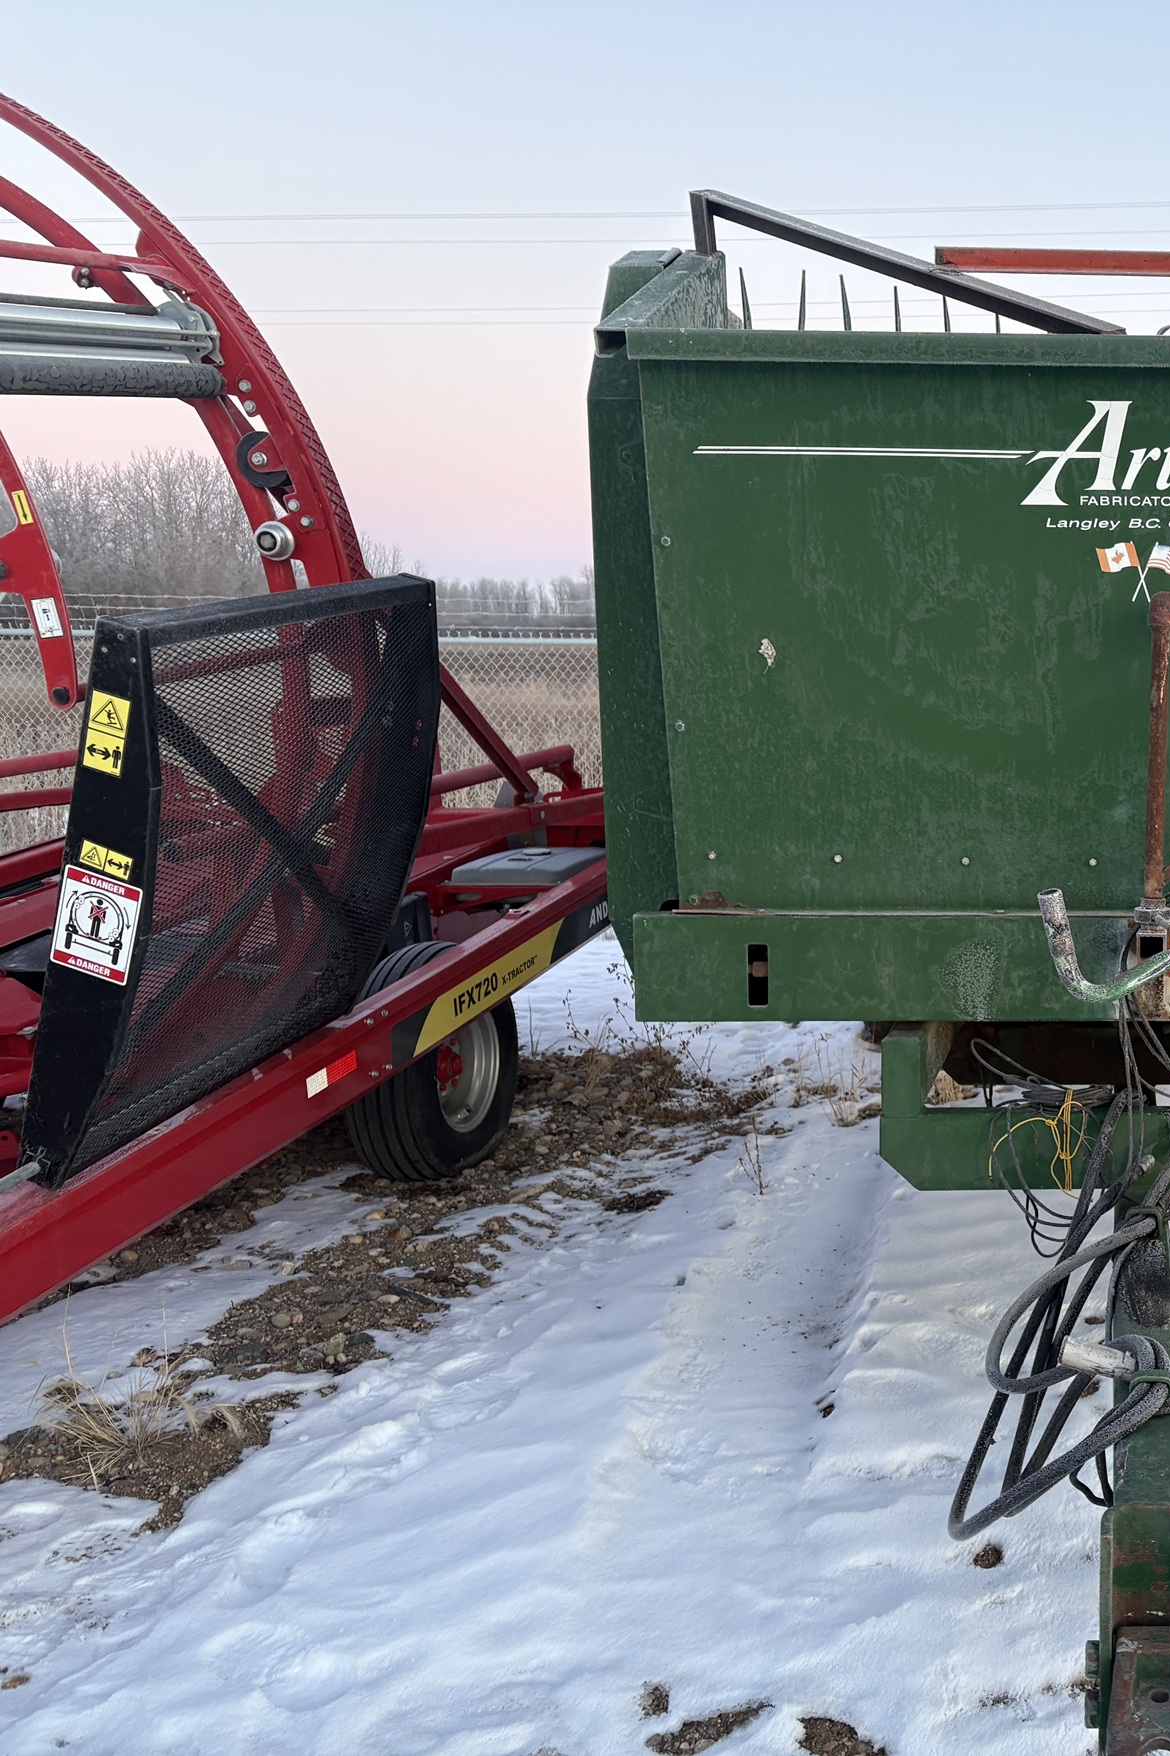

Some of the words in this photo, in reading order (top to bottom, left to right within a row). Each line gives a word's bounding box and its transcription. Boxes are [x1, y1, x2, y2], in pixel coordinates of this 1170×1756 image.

[1045, 517, 1121, 531] Langley
[1128, 517, 1162, 530] B.C.
[91, 876, 126, 896] DANGER
[76, 957, 111, 978] DANGER
[452, 971, 499, 1018] IFX720
